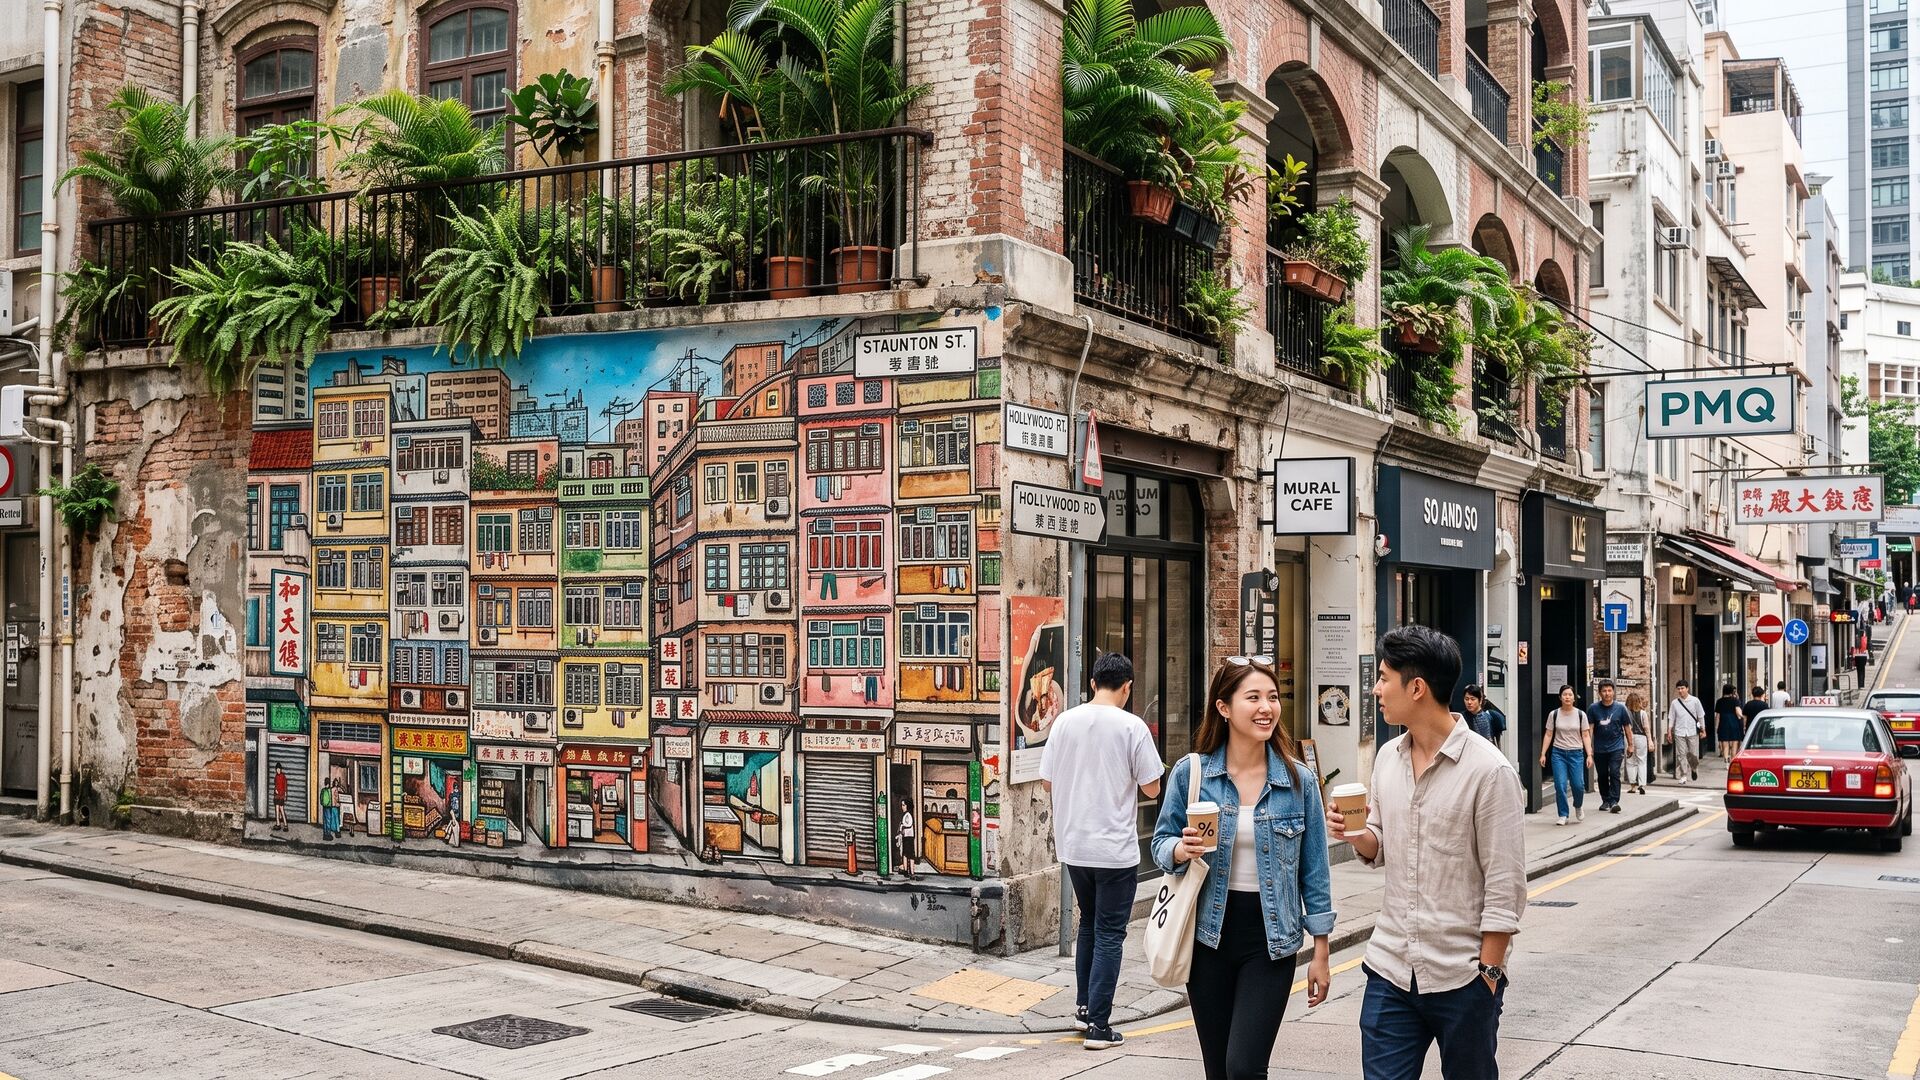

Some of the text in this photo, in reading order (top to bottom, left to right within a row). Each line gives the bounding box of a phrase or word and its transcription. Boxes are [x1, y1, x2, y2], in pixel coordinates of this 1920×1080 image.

[863, 334, 966, 354] STAUNTON ST.
[1661, 387, 1776, 426] PMQ
[1009, 409, 1054, 430] HOLLYWOOD
[1283, 481, 1341, 495] MURAL
[1019, 491, 1097, 516] HOLLYWOOD RD
[1290, 498, 1333, 512] CAFE
[1423, 497, 1478, 532] SO AND SO
[1801, 772, 1815, 780] HK
